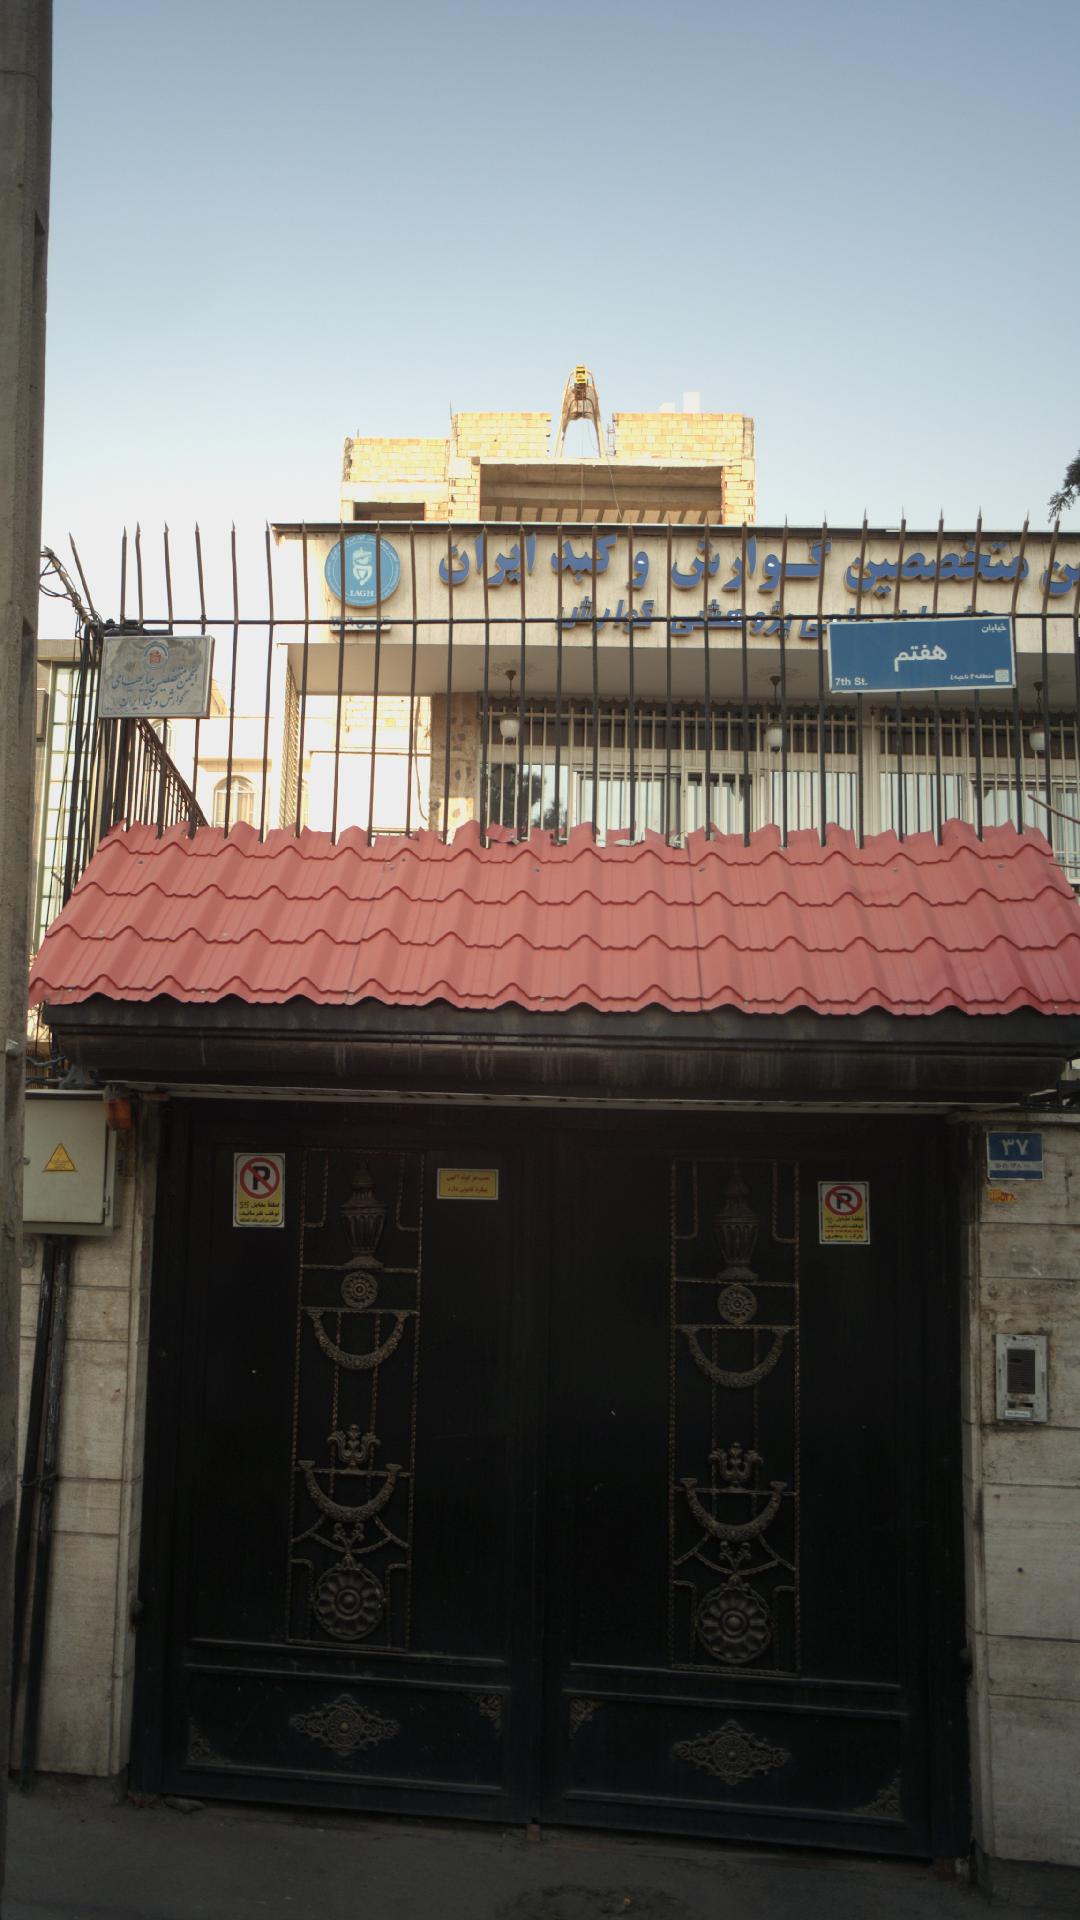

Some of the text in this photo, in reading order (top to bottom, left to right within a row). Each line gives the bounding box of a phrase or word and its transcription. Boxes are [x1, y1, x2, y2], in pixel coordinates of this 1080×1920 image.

[438, 531, 536, 586] ایران
[551, 533, 617, 583] کبد
[626, 550, 650, 588] و
[672, 536, 832, 592] گوارش
[844, 540, 1029, 597] متخصصین
[981, 623, 1007, 633] خیابان
[893, 643, 948, 673] هفتم
[835, 676, 868, 686] 7th St.
[1002, 1138, 1029, 1156] ۳۷
